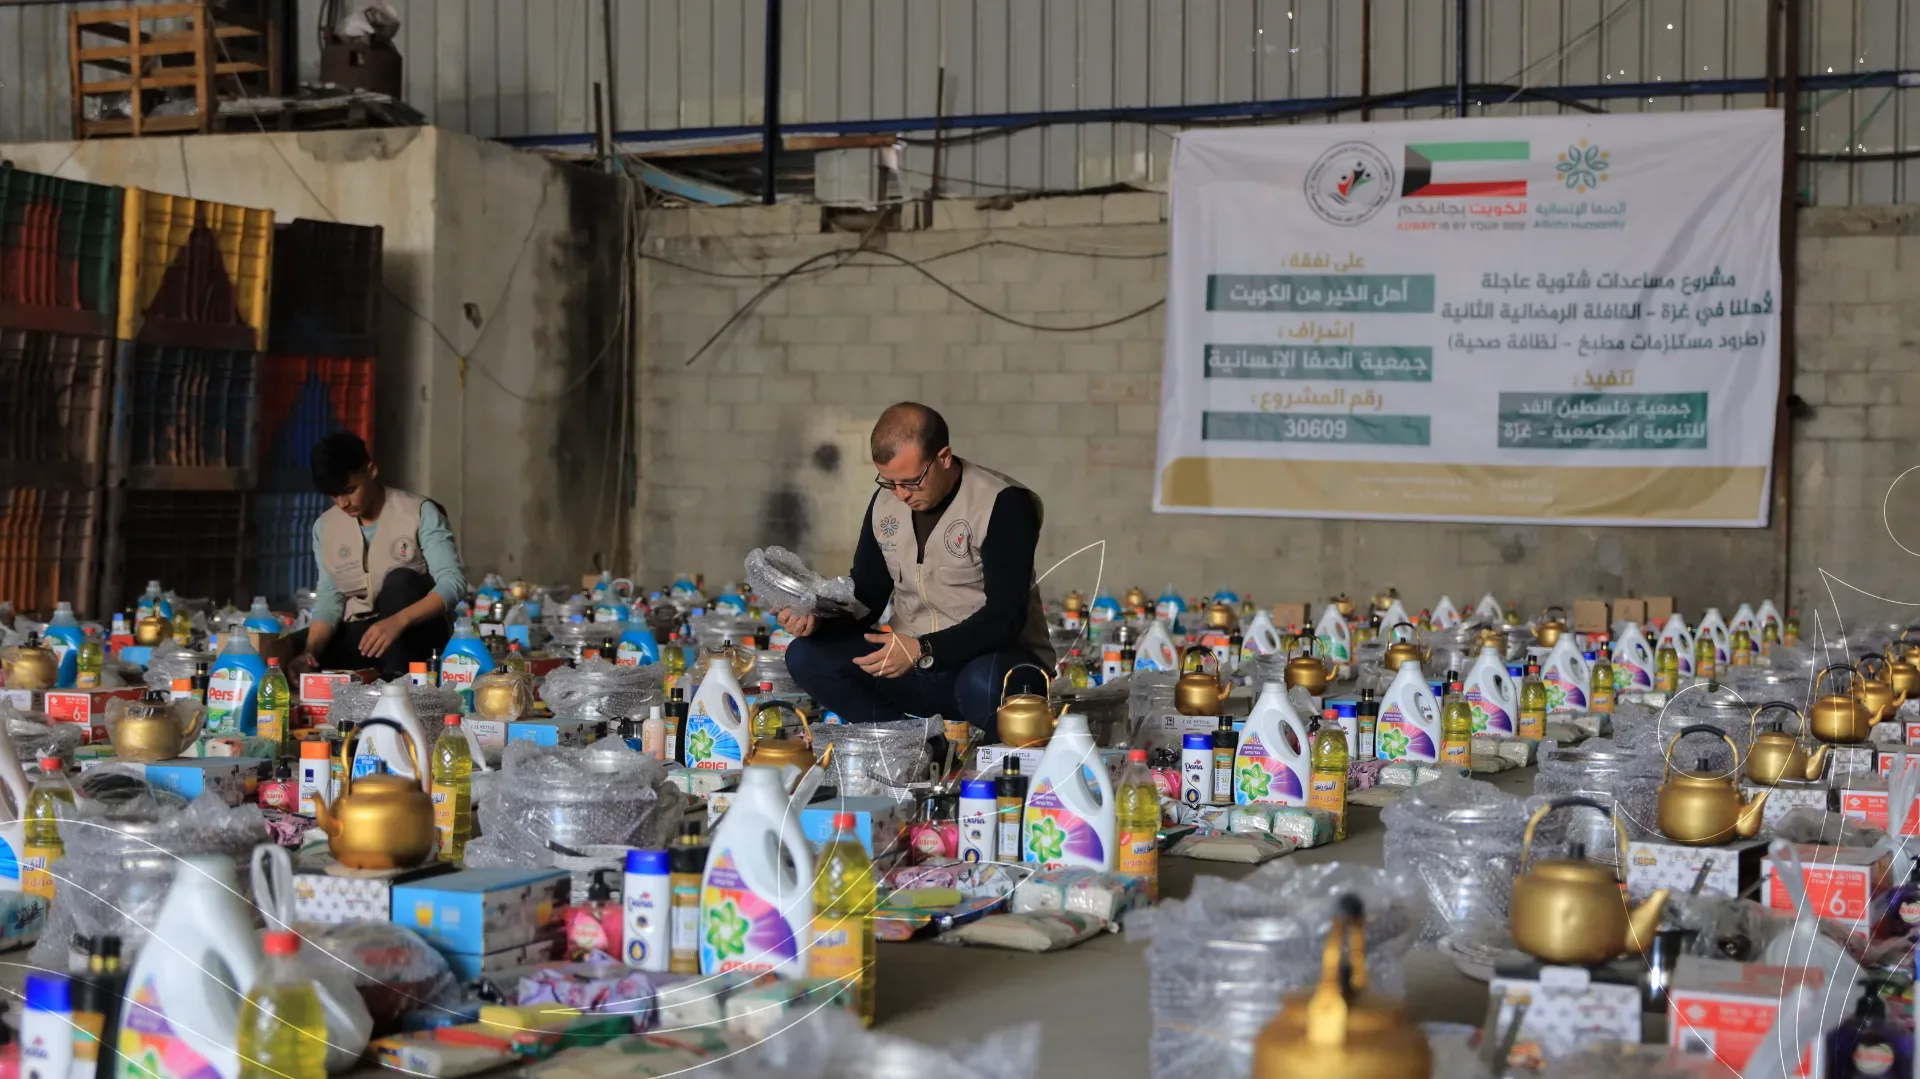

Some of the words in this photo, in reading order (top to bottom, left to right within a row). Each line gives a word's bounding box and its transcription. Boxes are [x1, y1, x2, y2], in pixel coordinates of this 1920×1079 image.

[1398, 202, 1466, 217] بجانبكم
[1470, 202, 1527, 216] الكويت
[1535, 202, 1586, 219] الإنسانية
[1591, 201, 1626, 215] الصفا
[1397, 221, 1436, 231] KUWAIT
[1453, 222, 1466, 230] BY
[1470, 222, 1499, 230] YOUR
[1502, 222, 1526, 230] SIDE
[1290, 253, 1330, 269] نفقة
[1335, 252, 1366, 273] على
[1481, 272, 1531, 293] عاجلة
[1536, 268, 1591, 293] شتوية
[1597, 272, 1675, 290] مساعدات
[1681, 266, 1736, 295] مشروع
[1230, 284, 1291, 306] الكويت
[1296, 288, 1321, 304] من
[1325, 285, 1368, 306] الخير
[1373, 277, 1408, 306] أهل
[1441, 299, 1494, 324] الثانية
[1583, 302, 1641, 320] القافلة
[1661, 302, 1690, 323] غزة
[1730, 289, 1773, 316] لأهلنا
[1500, 303, 1577, 324] الرمضانية
[1696, 302, 1724, 327] في
[1289, 321, 1355, 345] إشراف
[1448, 333, 1500, 353] صحية)
[1507, 333, 1557, 350] نظافة
[1631, 333, 1713, 354] مستلزمات
[1718, 330, 1766, 350] (طرود
[1578, 333, 1624, 357] مطبخ
[1208, 349, 1296, 376] الإنسانية
[1302, 351, 1353, 370] الصفا
[1360, 351, 1428, 375] جمعية
[1583, 368, 1635, 391] تنفيذ
[1259, 385, 1345, 412] المشروع
[1350, 389, 1383, 412] رقم
[1518, 399, 1552, 415] الغد
[1556, 399, 1631, 420] فلسطين
[1636, 401, 1691, 420] جمعية
[1284, 418, 1347, 438] 30609
[1504, 421, 1532, 442] غزة
[1552, 423, 1638, 444] المجتمعية
[1643, 421, 1706, 443] للتنمية
[73, 706, 81, 721] 6
[1184, 762, 1203, 771] Dana
[963, 816, 986, 825] Dana
[1829, 889, 1846, 915] 6
